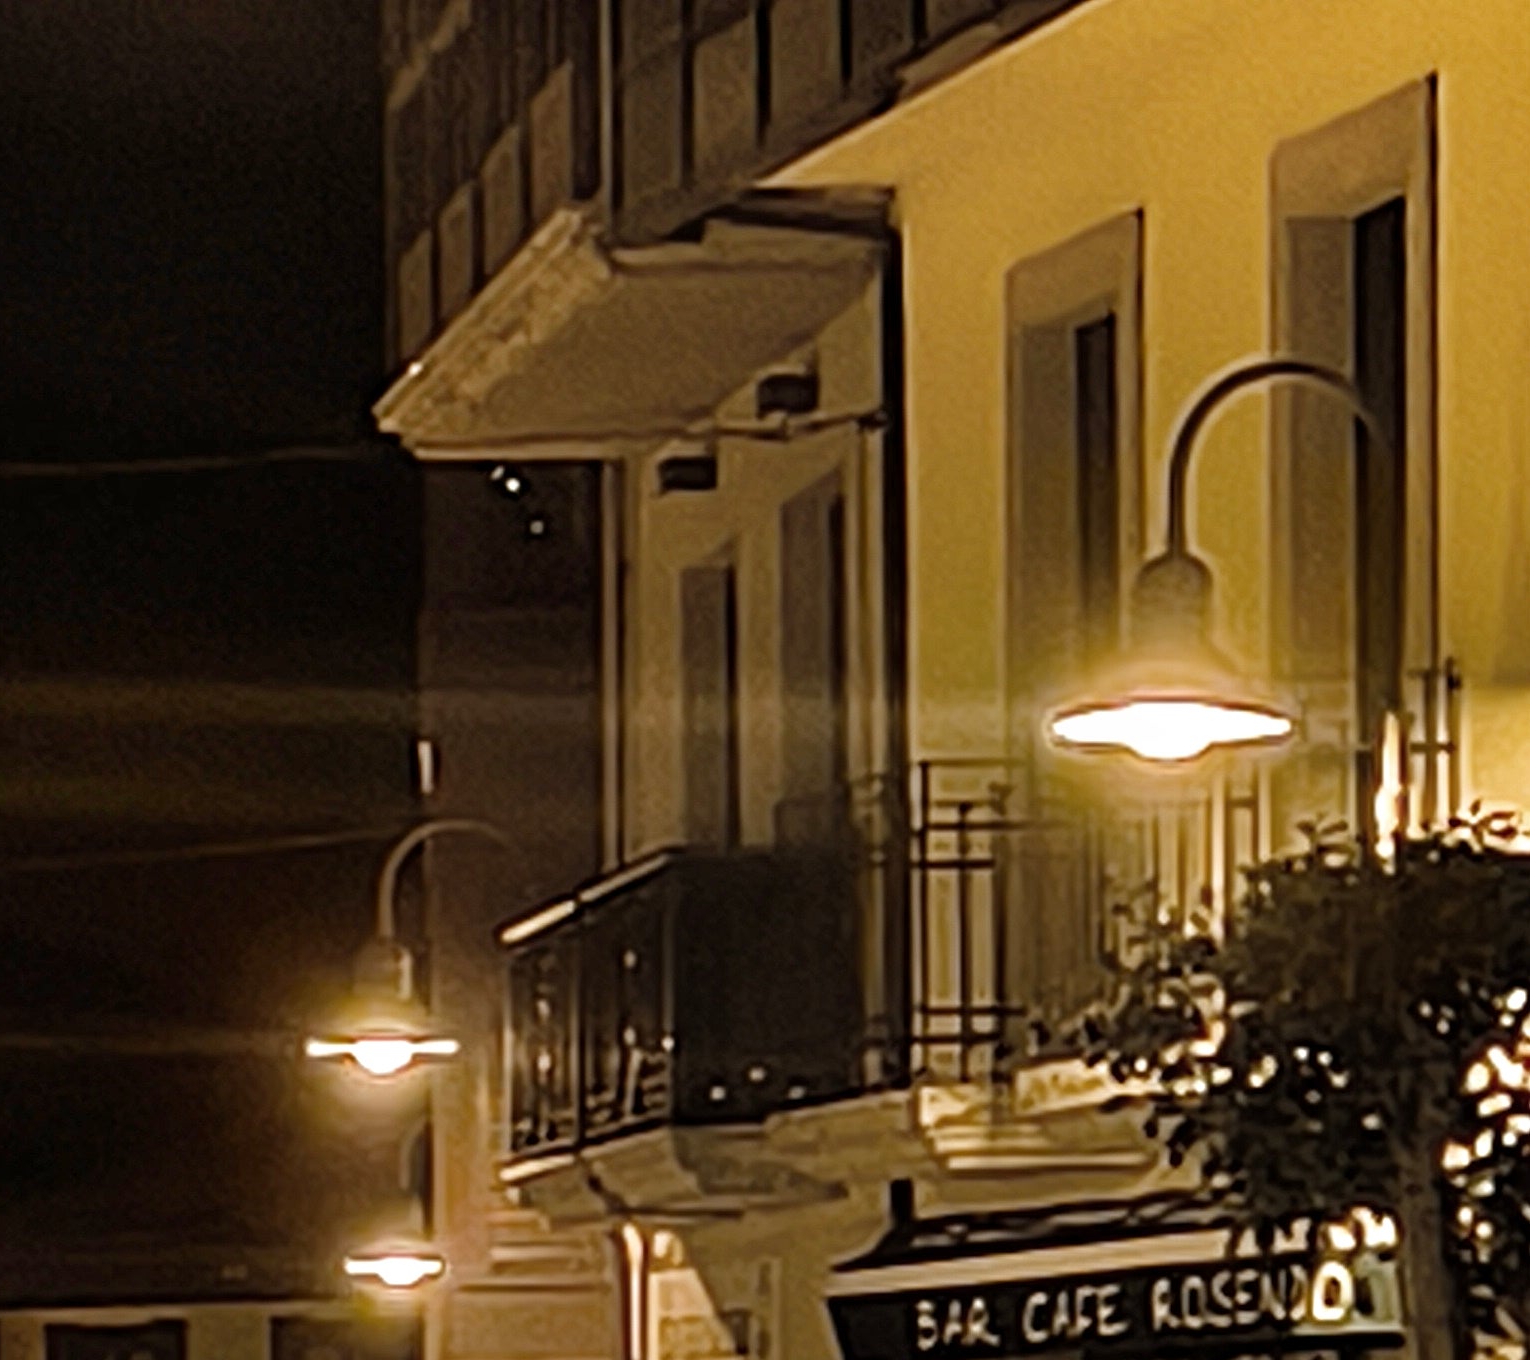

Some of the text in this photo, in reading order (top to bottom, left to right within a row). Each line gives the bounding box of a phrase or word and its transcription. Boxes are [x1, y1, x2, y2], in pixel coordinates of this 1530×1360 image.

[916, 1261, 1353, 1349] BAR CAFE ROSENDO
